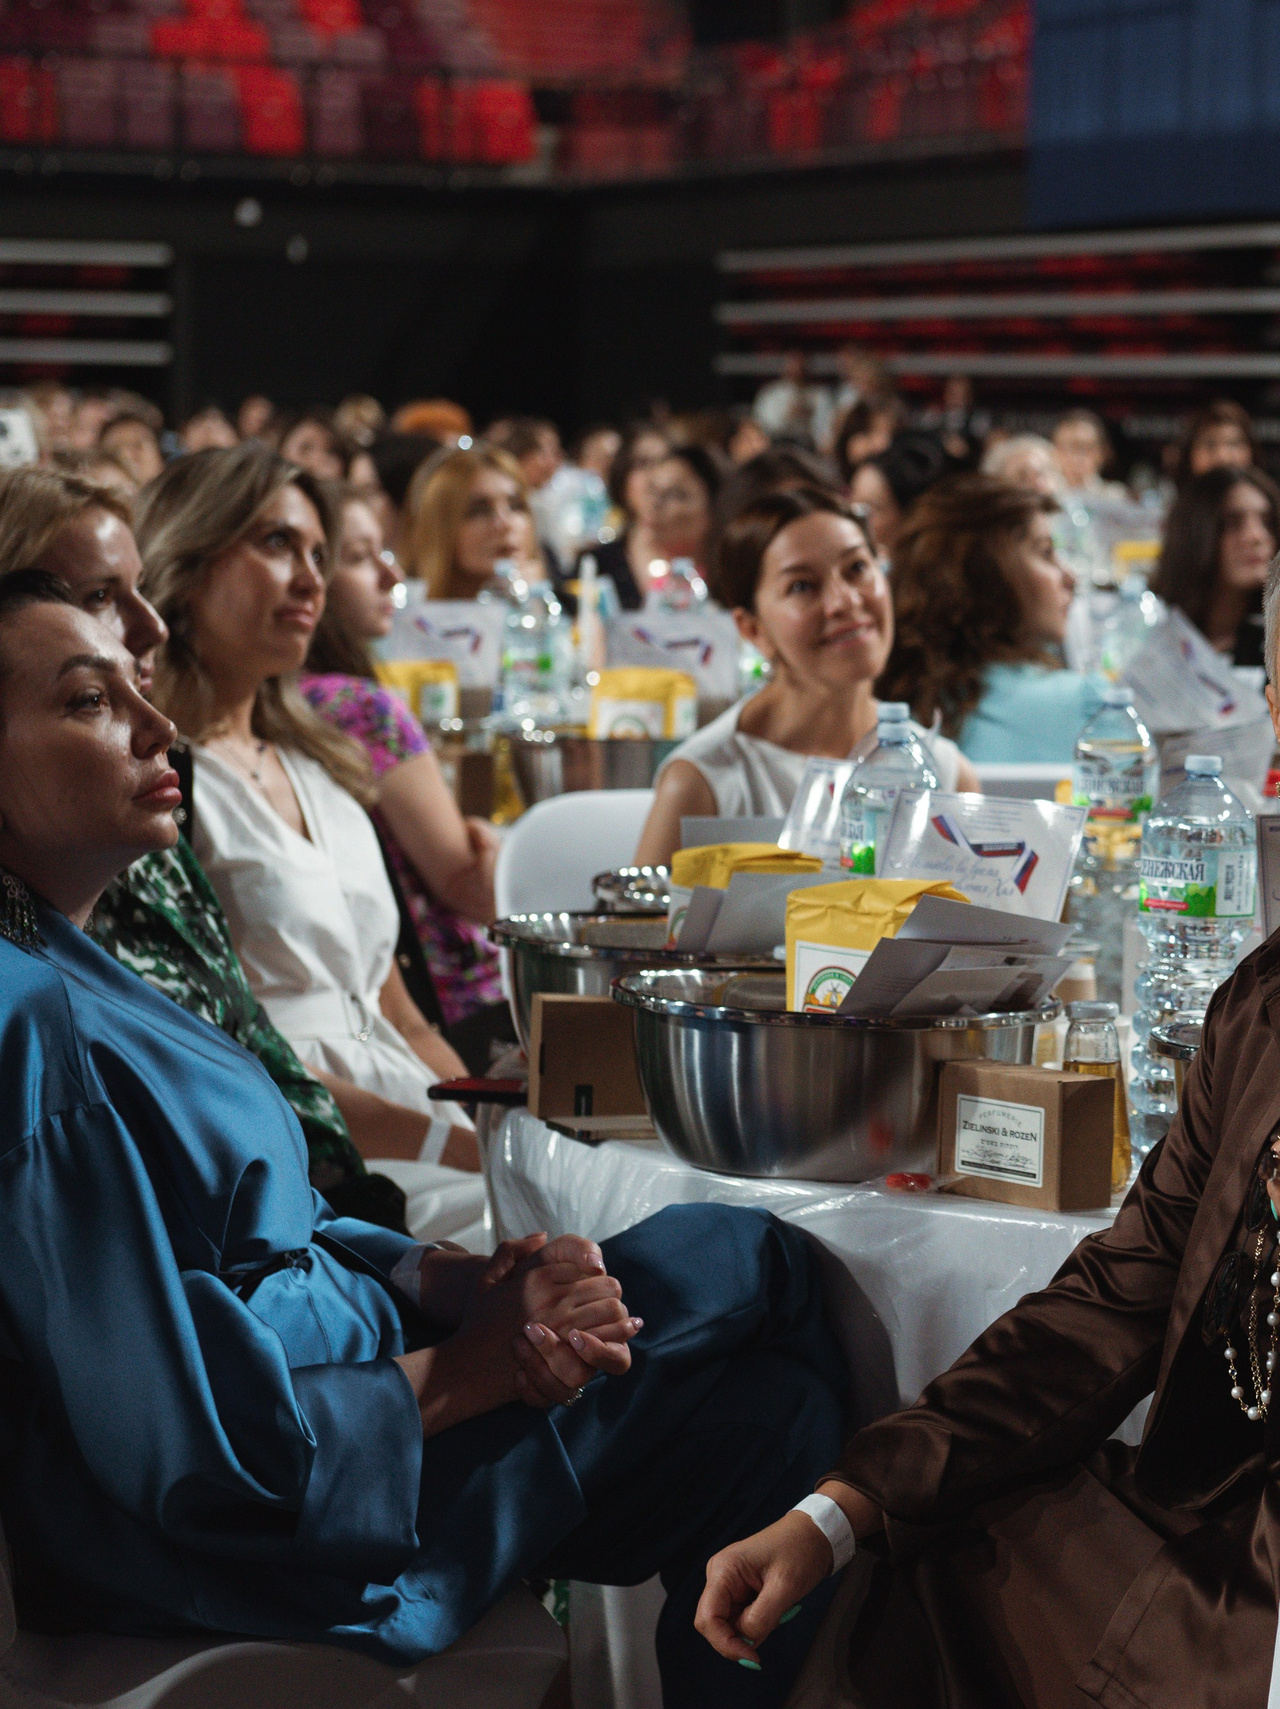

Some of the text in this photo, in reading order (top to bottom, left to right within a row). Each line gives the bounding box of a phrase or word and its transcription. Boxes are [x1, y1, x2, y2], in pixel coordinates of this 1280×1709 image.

[1141, 859, 1205, 881] ЕНЕЖСКАЯ
[962, 1120, 1000, 1136] ZIELINSKI
[1001, 1127, 1009, 1138] &
